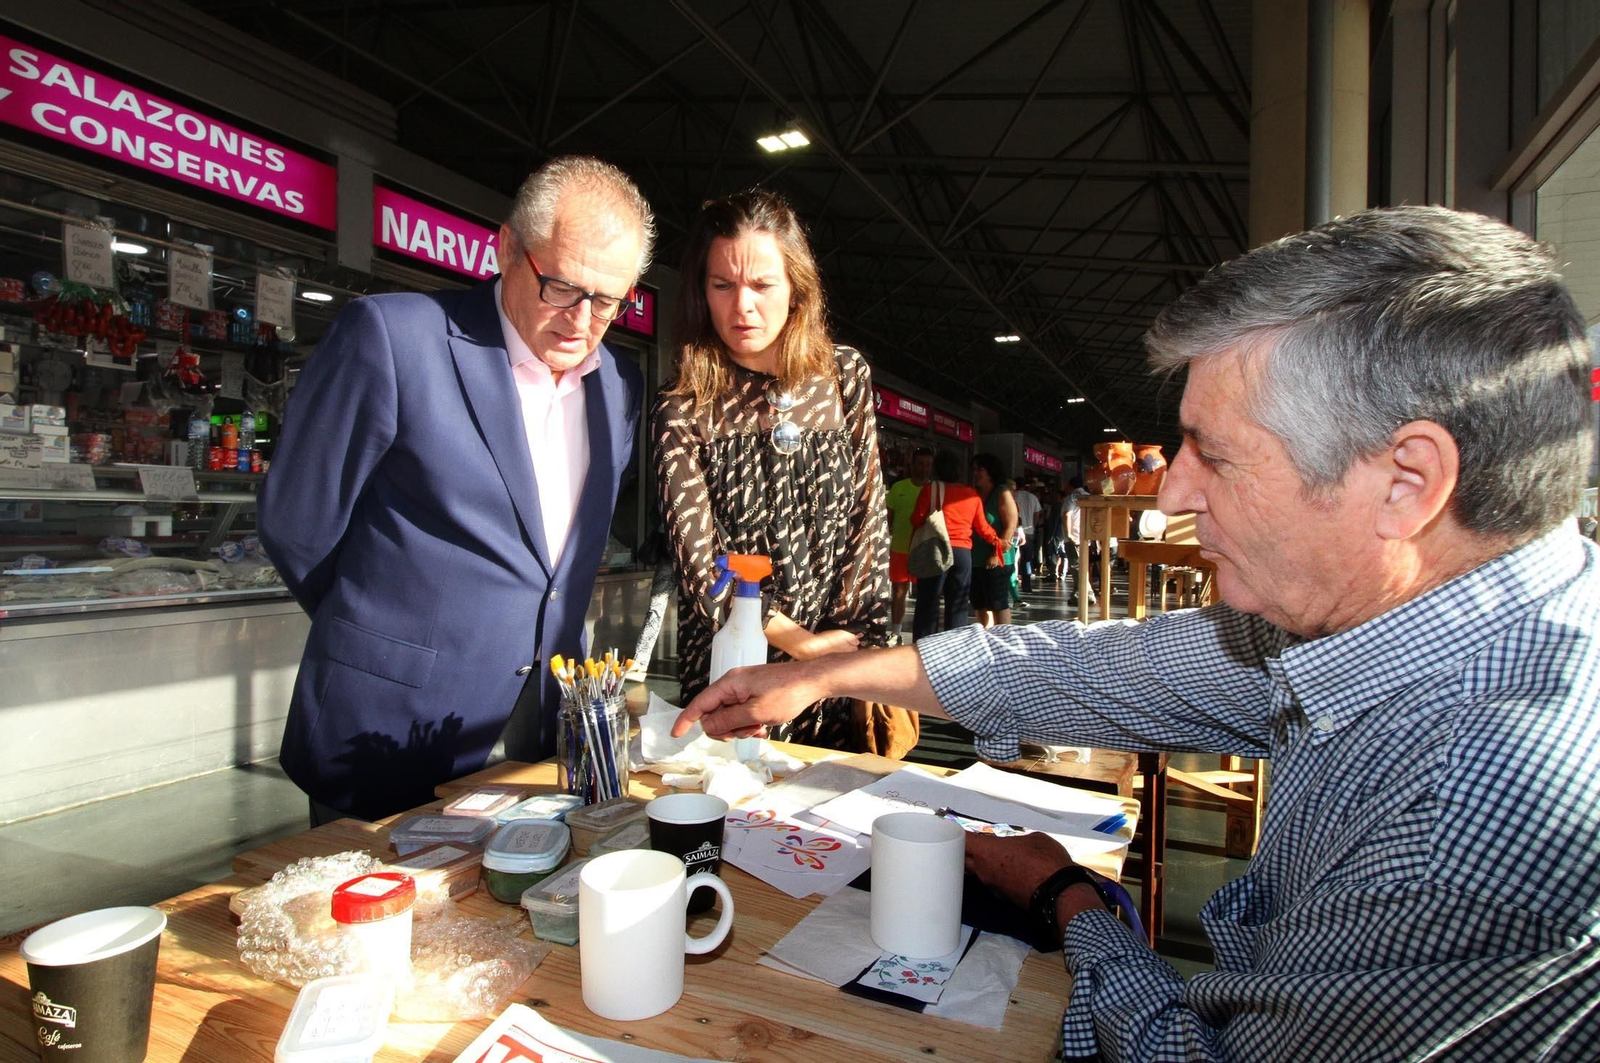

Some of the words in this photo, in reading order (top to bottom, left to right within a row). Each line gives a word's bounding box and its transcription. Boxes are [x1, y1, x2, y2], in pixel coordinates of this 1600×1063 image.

[9, 49, 286, 172] SALAZONES
[31, 102, 305, 214] CONSERVAS
[685, 848, 719, 863] SAIMAZA
